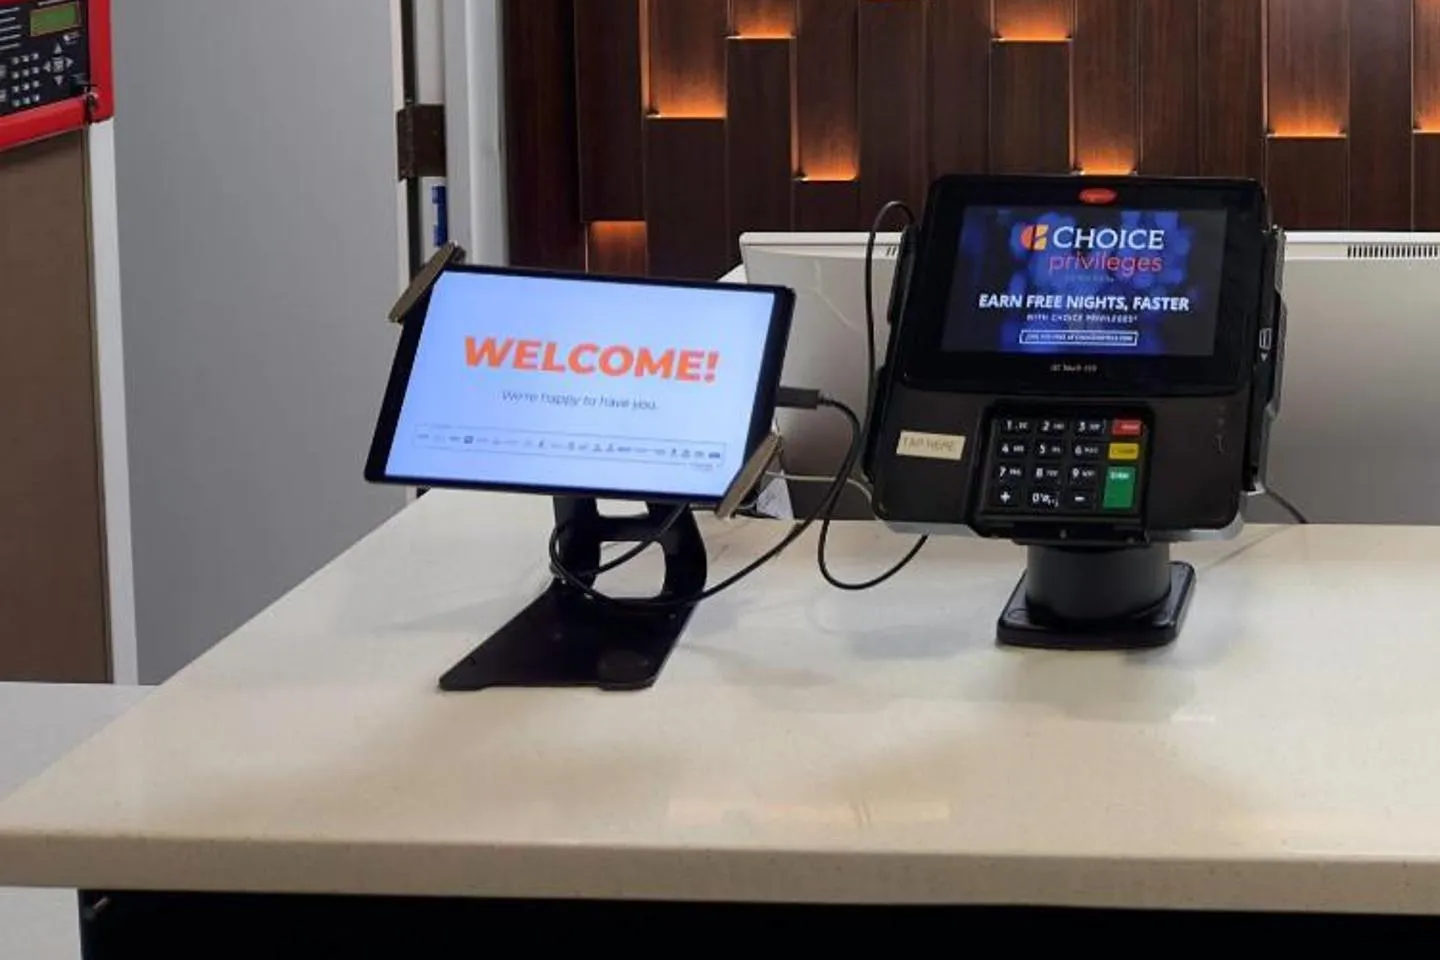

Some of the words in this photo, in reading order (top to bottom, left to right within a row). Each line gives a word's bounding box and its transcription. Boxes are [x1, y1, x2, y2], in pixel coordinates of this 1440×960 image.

[1053, 225, 1165, 250] CHOICE
[1049, 251, 1163, 278] privileges
[978, 293, 1023, 309] EARN
[1026, 294, 1063, 309] FREE
[1066, 295, 1128, 312] NIGHTS,
[1132, 296, 1190, 311] FASTER
[464, 336, 719, 383] WELCOME!
[540, 392, 581, 409] happy
[583, 394, 597, 406] to
[600, 394, 632, 409] have
